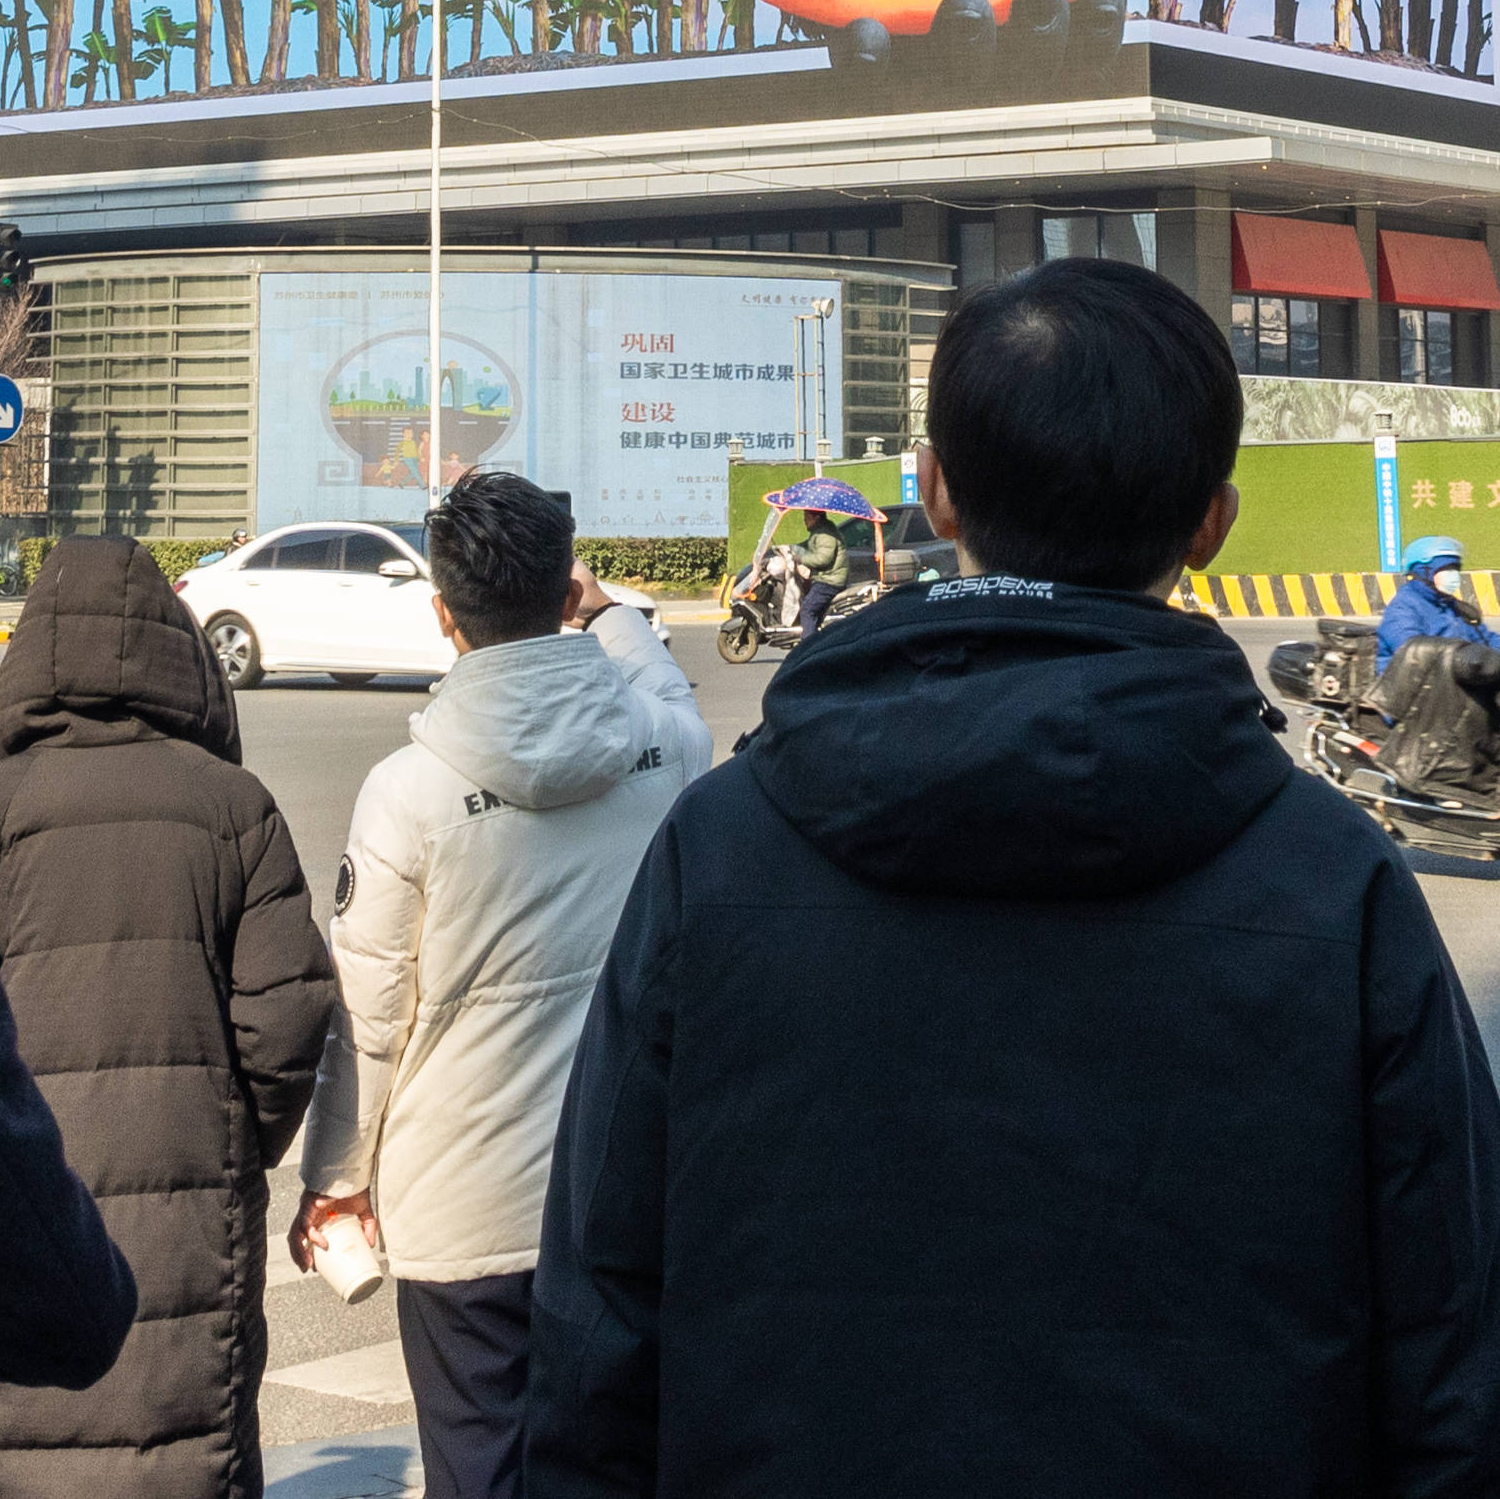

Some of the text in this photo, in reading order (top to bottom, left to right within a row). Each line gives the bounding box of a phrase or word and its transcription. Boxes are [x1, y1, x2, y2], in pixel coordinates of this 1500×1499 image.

[621, 333, 675, 353] 巩固
[620, 362, 795, 381] 国家卫生城市成果
[621, 402, 676, 423] 建设
[620, 432, 795, 450] 健康中国典范城市
[928, 576, 1053, 597] BOSIDENG
